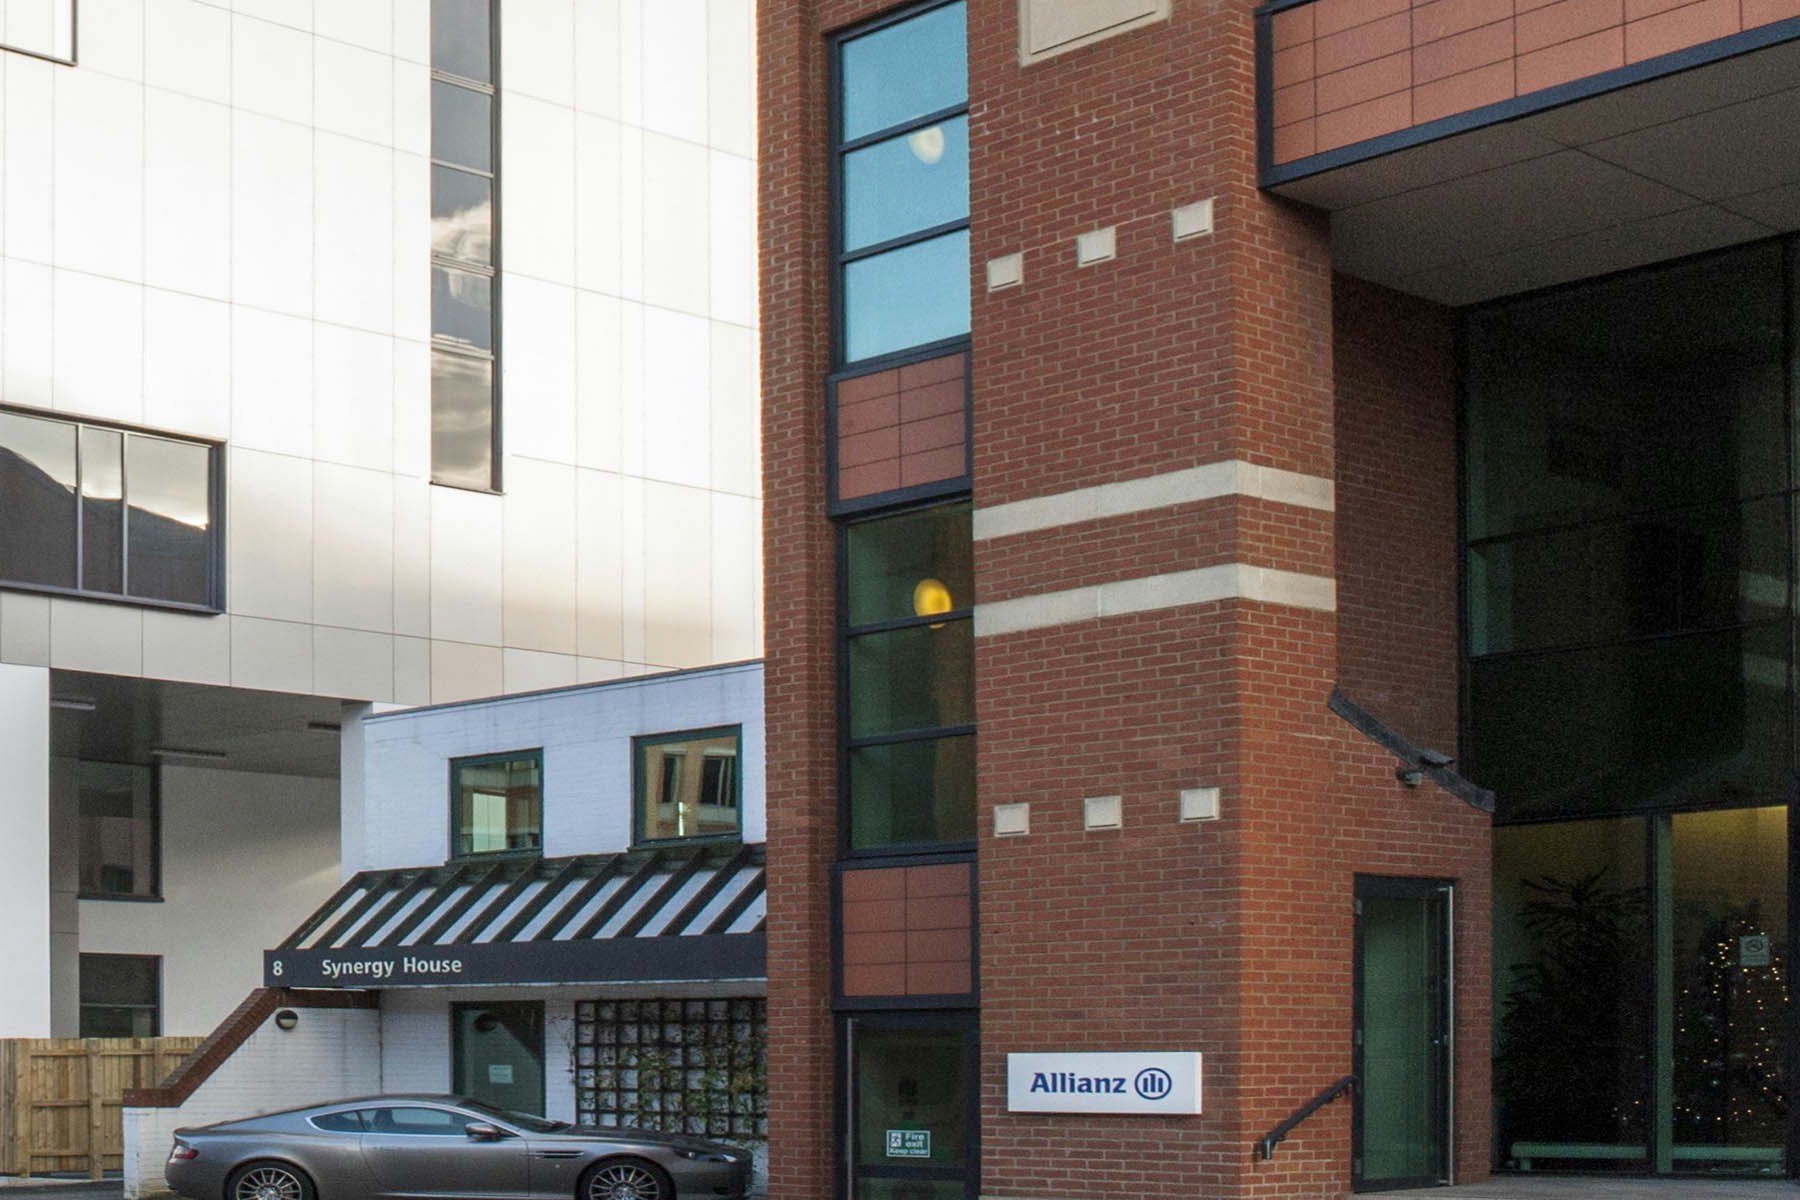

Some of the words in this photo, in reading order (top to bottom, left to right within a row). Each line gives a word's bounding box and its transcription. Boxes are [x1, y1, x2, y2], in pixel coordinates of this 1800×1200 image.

[272, 960, 283, 976] 8
[322, 959, 395, 978] Synergy
[403, 957, 462, 973] House
[1030, 1072, 1127, 1093] Allianz
